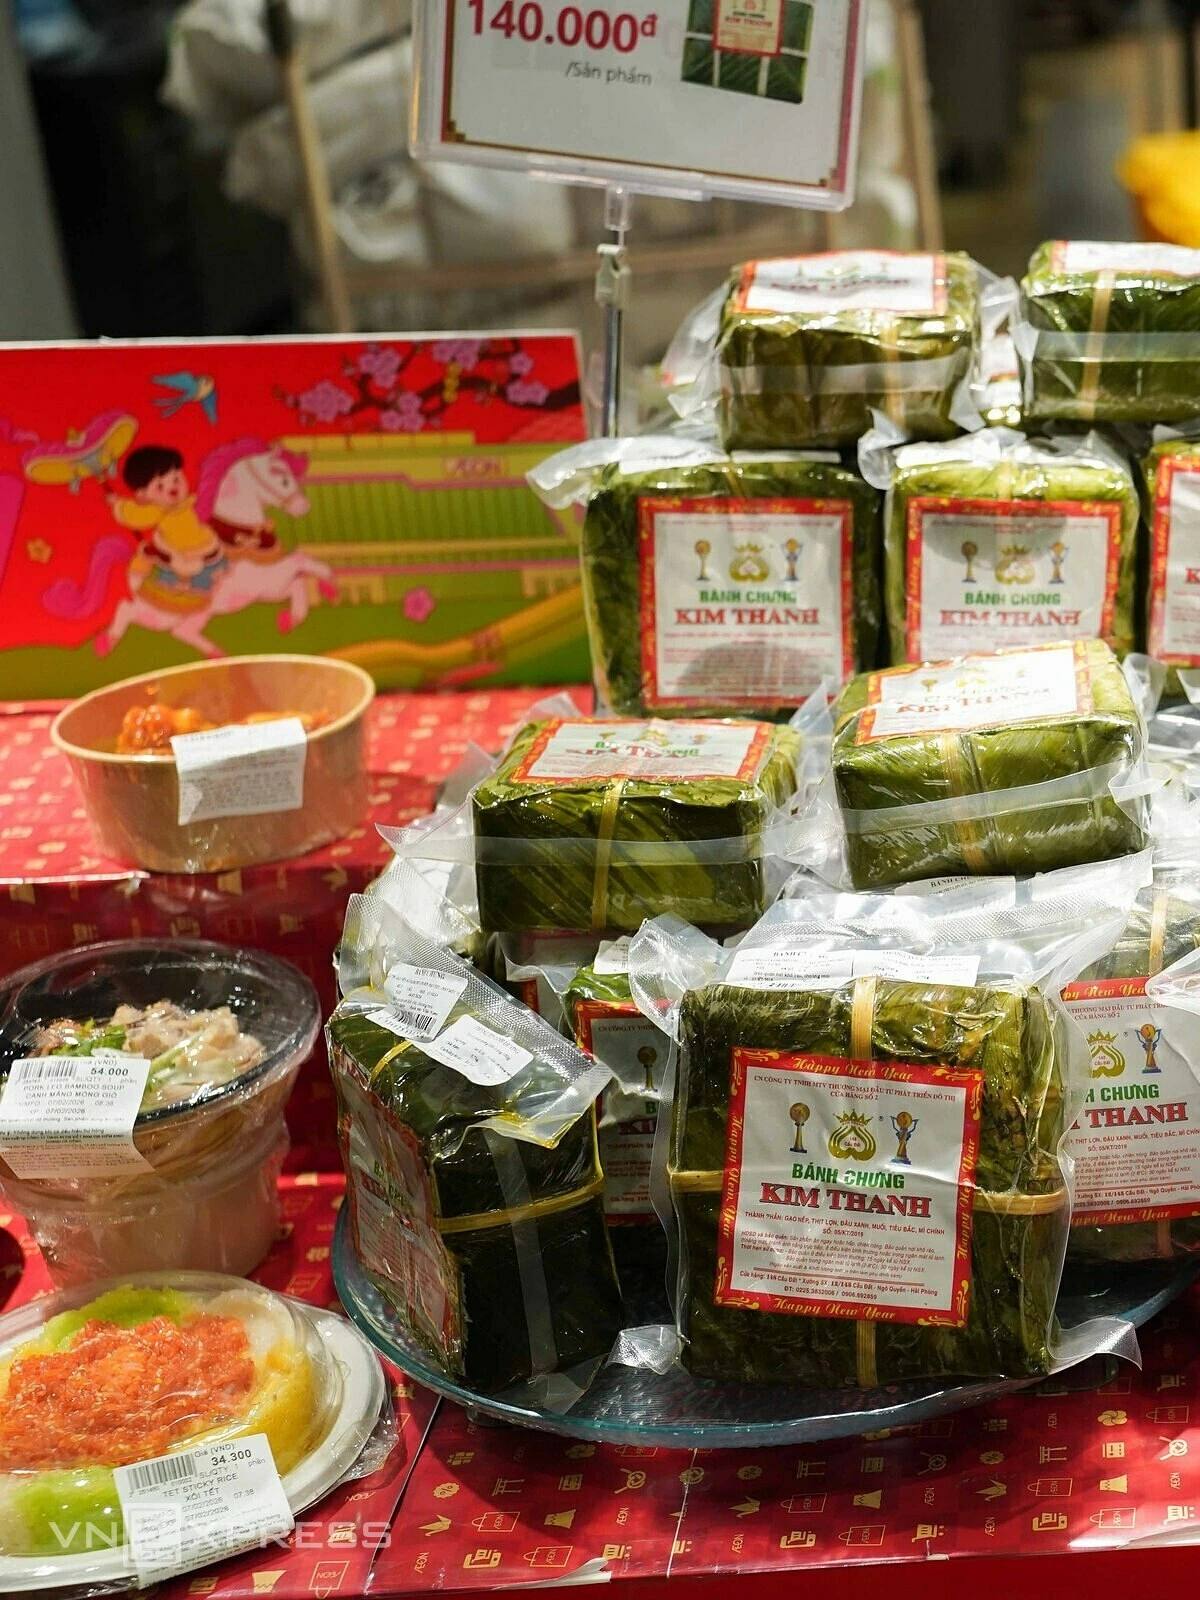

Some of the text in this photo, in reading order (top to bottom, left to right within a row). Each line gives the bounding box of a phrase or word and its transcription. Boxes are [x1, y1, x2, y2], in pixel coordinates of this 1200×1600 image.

[699, 589, 741, 604] BÁNH
[964, 591, 999, 606] BÁNH
[674, 608, 820, 625] KIM THANH
[939, 610, 1082, 626] KIM THANH
[1085, 983, 1146, 998] New Yea
[91, 1067, 129, 1076] 54.000
[792, 1057, 914, 1080] Happy New Year
[1085, 1102, 1189, 1129] THANH
[792, 1162, 839, 1184] BÁNH
[759, 1182, 932, 1218] KIM THANH
[1103, 1209, 1136, 1223] New
[1138, 1208, 1172, 1225] Year
[773, 1297, 896, 1320] Happy New Year
[211, 1449, 252, 1466] 34.300
[162, 1473, 238, 1498] TET STICKY RICE
